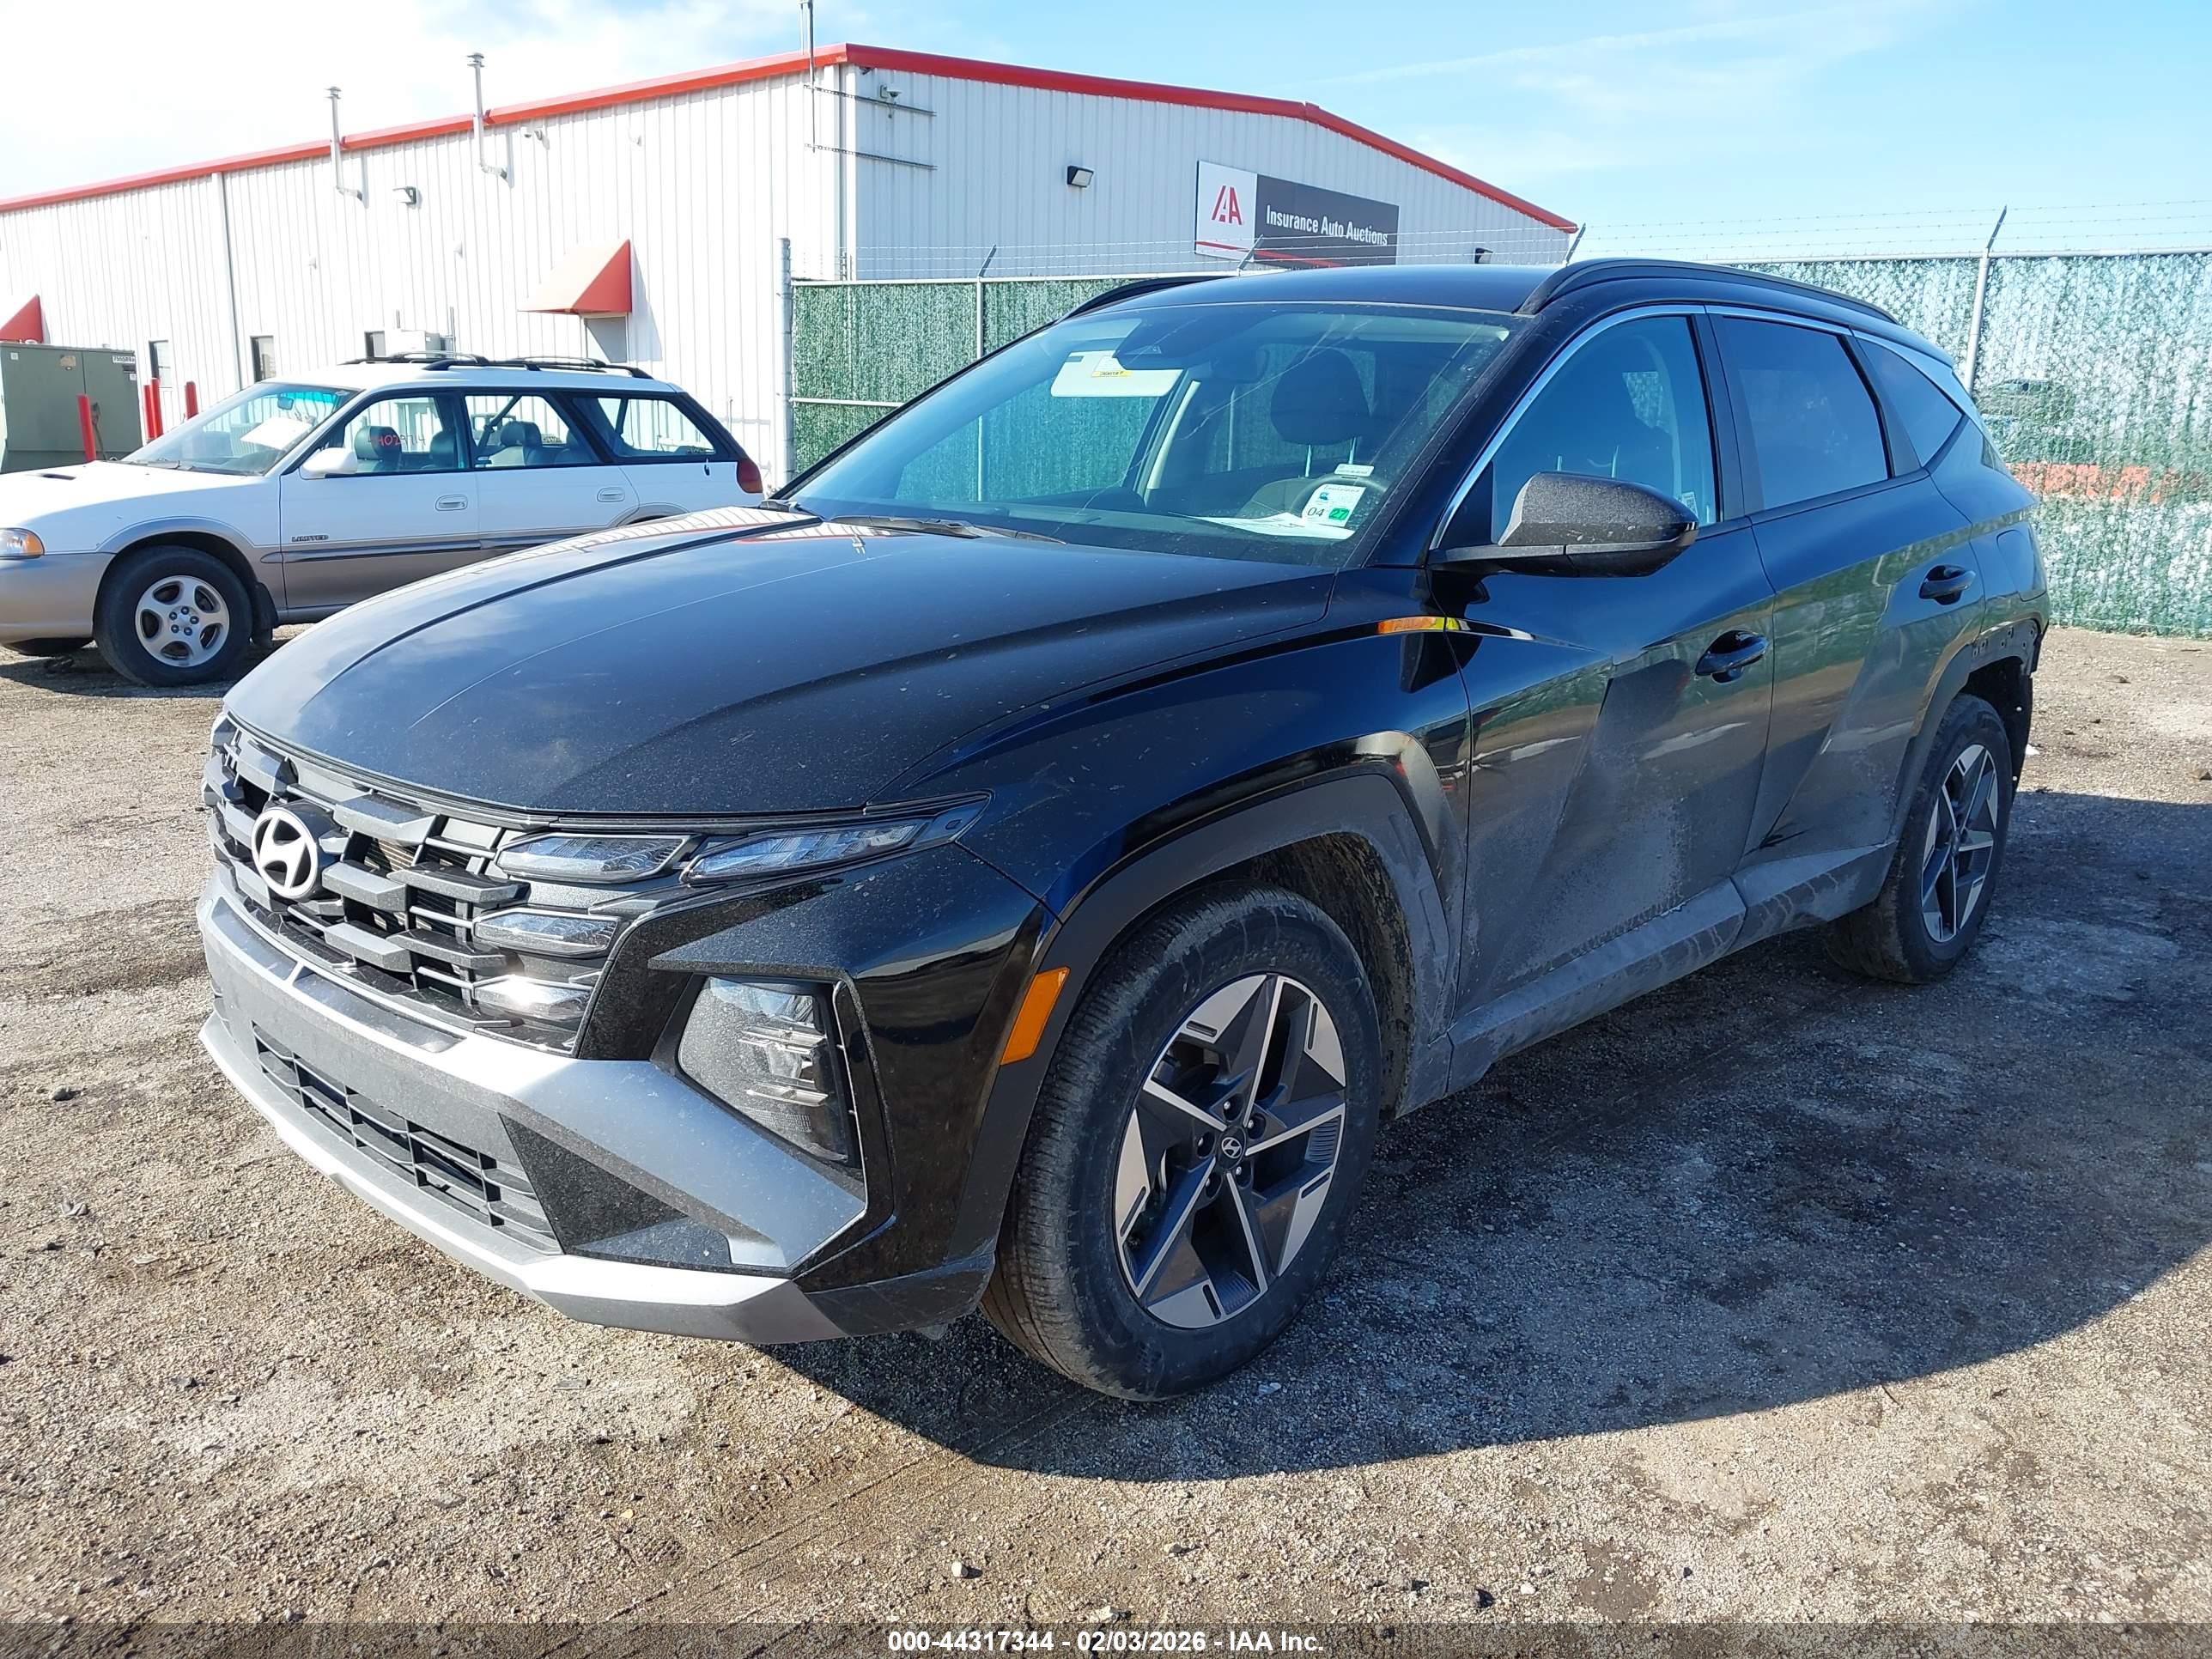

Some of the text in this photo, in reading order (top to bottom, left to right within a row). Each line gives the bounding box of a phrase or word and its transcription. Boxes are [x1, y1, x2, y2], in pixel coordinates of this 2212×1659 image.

[1266, 204, 1389, 246] Insurance Auto Auctions
[1307, 507, 1325, 517] 04
[1331, 508, 1347, 520] 27
